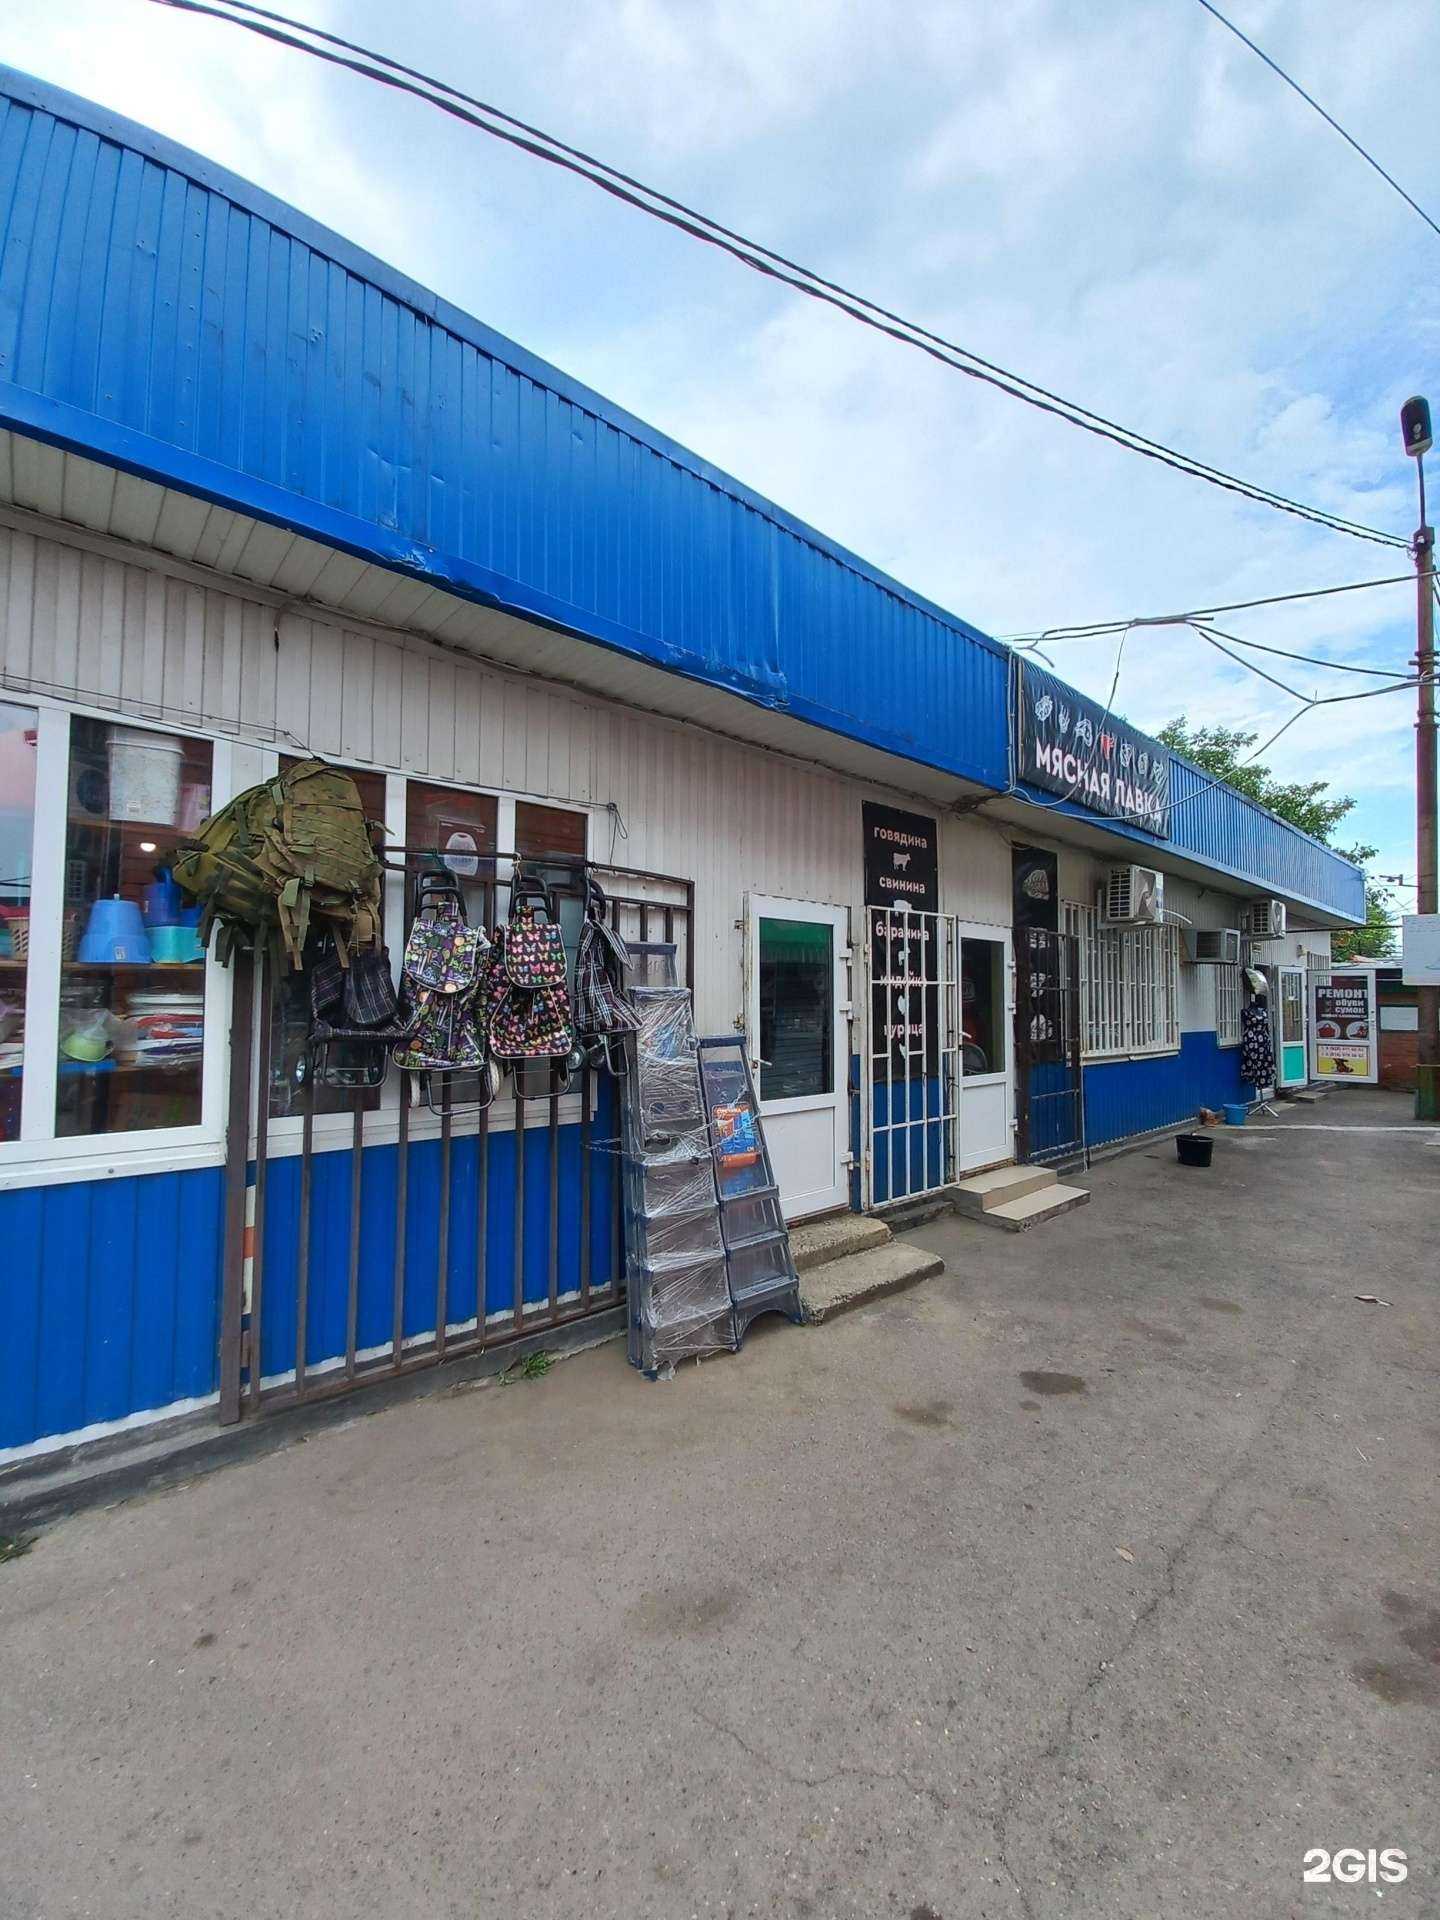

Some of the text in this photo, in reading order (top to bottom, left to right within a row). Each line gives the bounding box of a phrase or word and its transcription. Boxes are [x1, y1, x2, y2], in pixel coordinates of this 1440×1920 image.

[1035, 738, 1162, 824] МЯСНАЯ ЛАВКА
[873, 826, 928, 849] говядина
[879, 876, 926, 894] свинина
